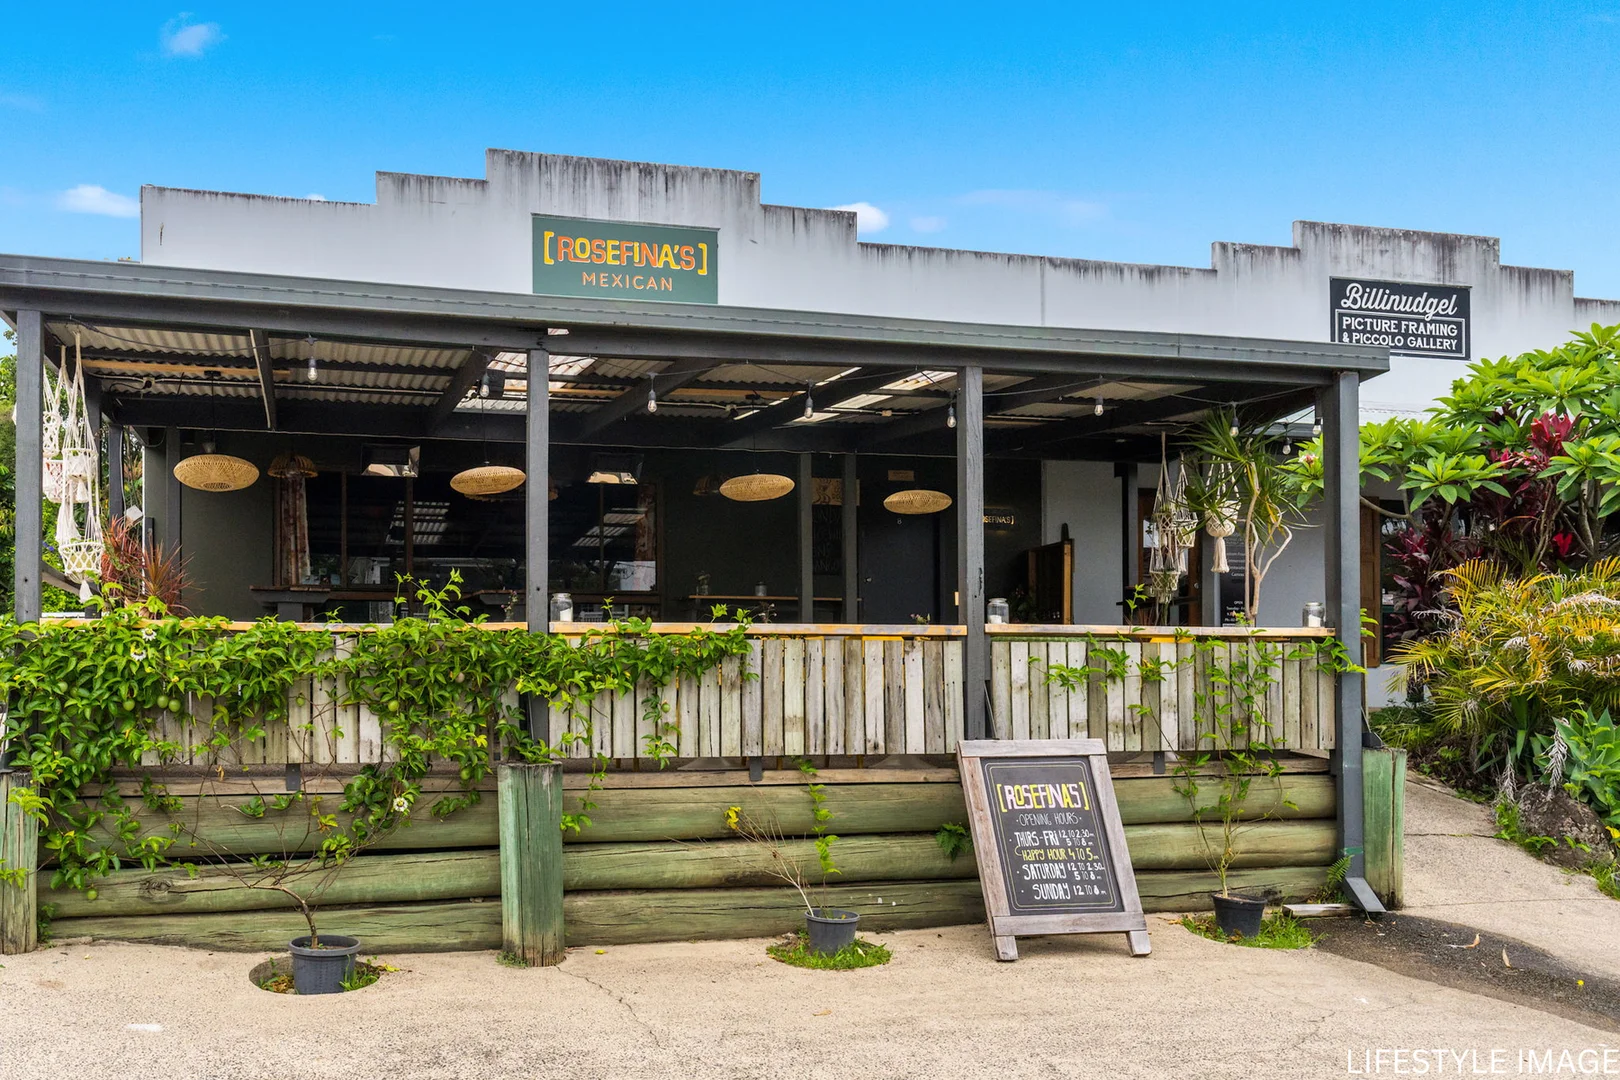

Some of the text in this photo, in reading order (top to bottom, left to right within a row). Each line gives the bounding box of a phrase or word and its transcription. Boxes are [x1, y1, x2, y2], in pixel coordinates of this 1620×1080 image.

[582, 271, 673, 291] MEXICAN
[1340, 283, 1458, 321] Billinudgel
[1342, 317, 1458, 337] PICTURE FRAMING
[1342, 332, 1458, 350] & PICCOLO GALLERY
[1019, 812, 1079, 826] OPENING HOURS
[1065, 838, 1072, 846] 5
[1068, 829, 1076, 838] TO
[1046, 848, 1068, 860] HOUR
[1067, 848, 1076, 860] 4
[1075, 848, 1086, 861] TO
[1022, 862, 1067, 880] SATURDAY
[1067, 862, 1077, 871] 12
[1077, 862, 1086, 871] TO
[1074, 871, 1081, 880] 5
[1032, 882, 1071, 900] SUNDAY
[1073, 885, 1085, 896] 12
[1084, 884, 1093, 896] TO
